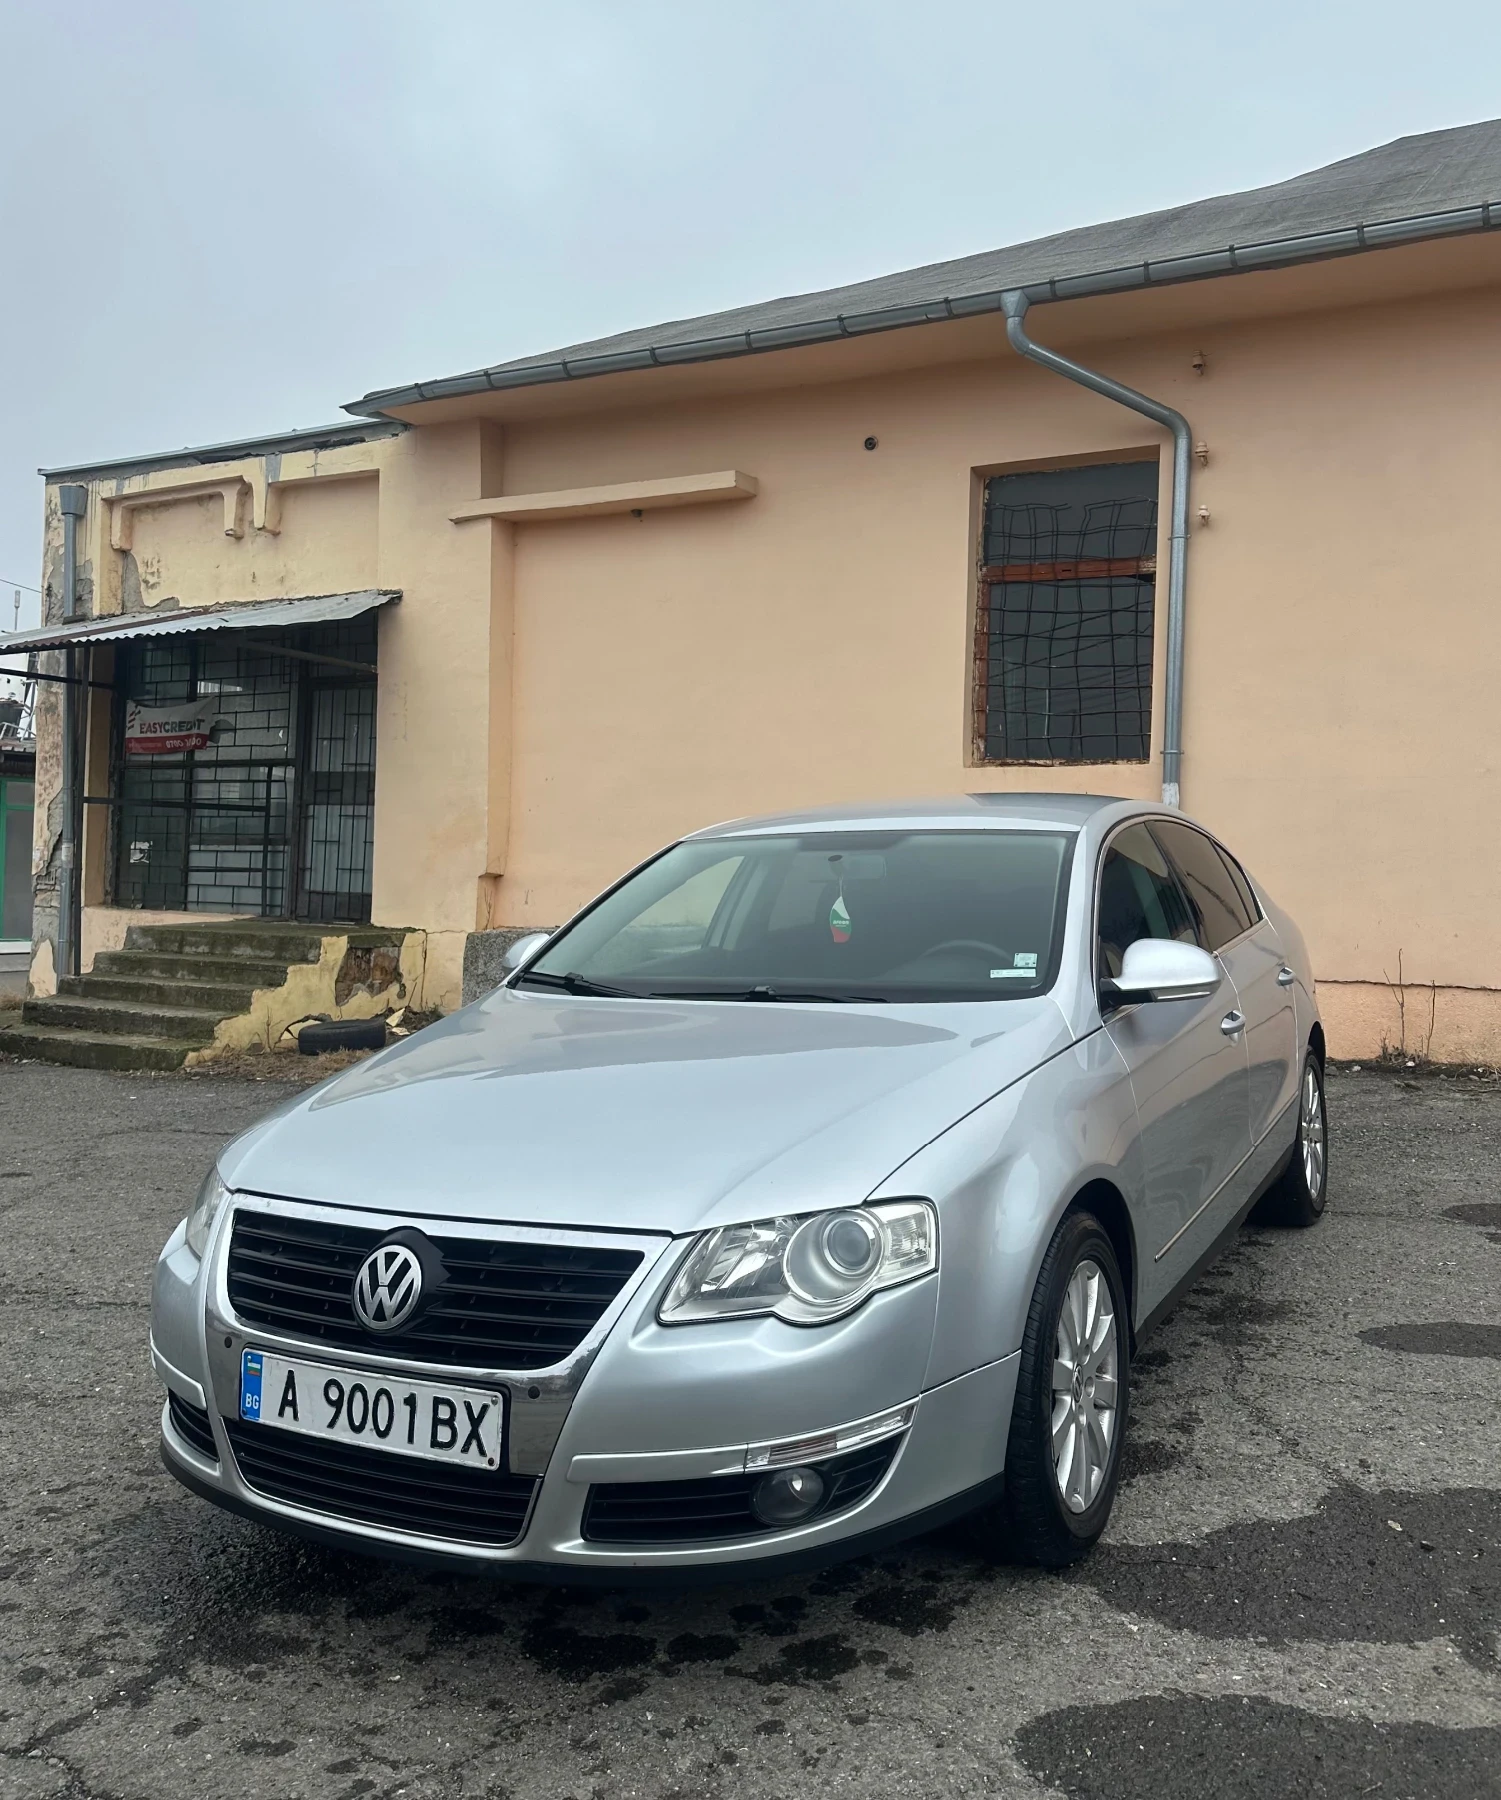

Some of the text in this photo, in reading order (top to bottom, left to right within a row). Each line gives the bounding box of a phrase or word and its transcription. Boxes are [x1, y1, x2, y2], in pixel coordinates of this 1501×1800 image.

[140, 718, 205, 734] EASYCREDIT
[245, 1393, 260, 1410] BG
[278, 1369, 300, 1422] A
